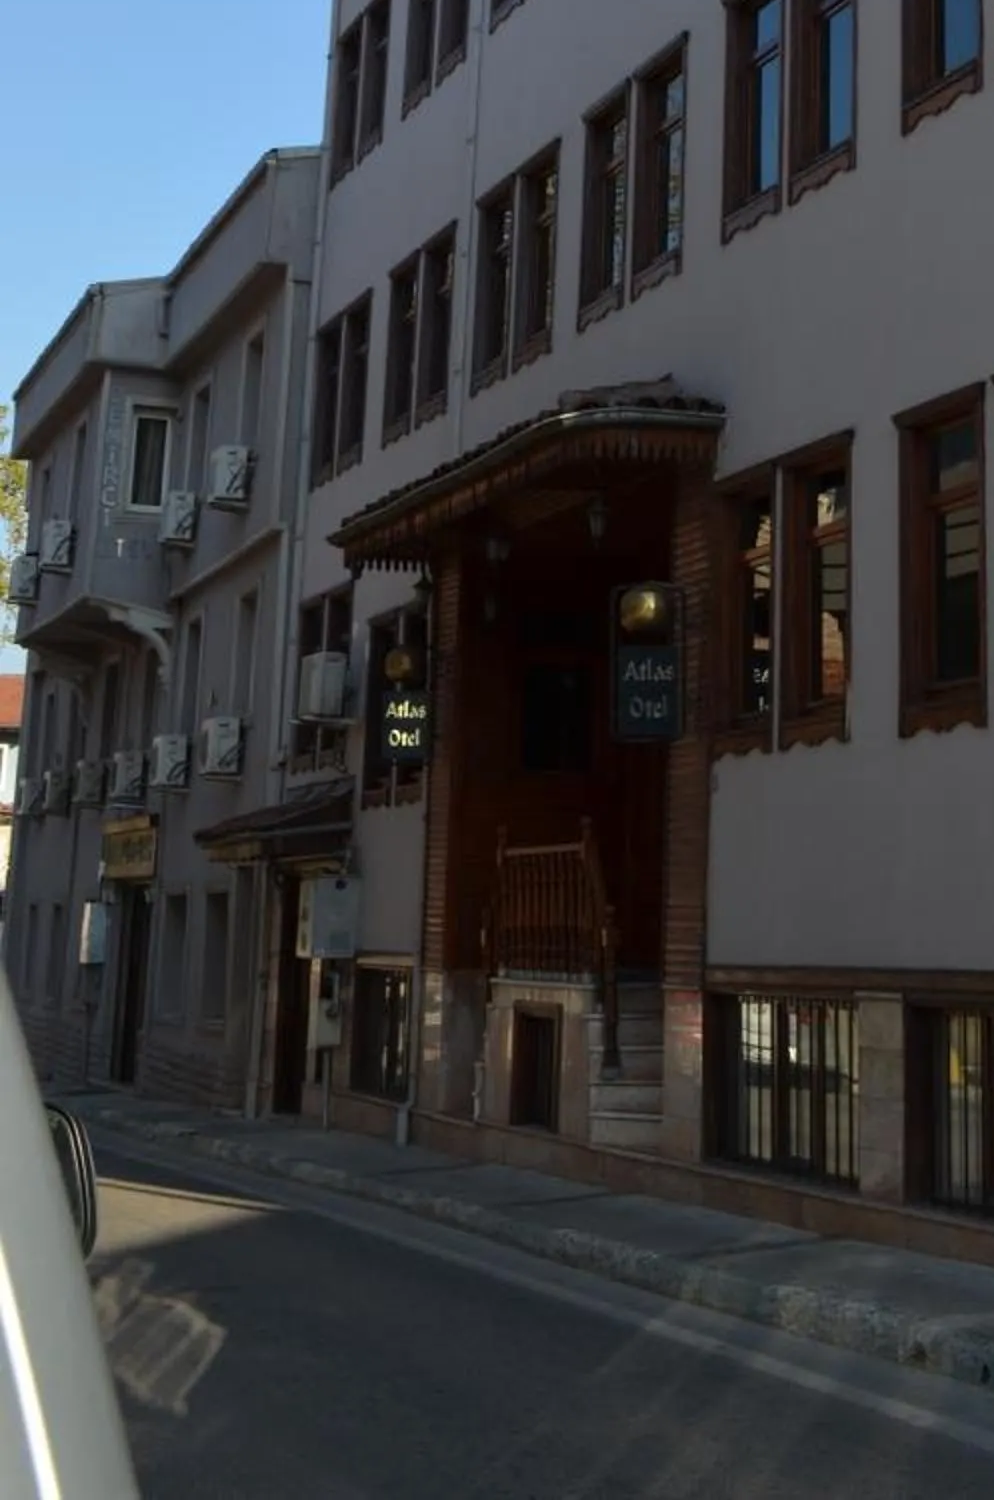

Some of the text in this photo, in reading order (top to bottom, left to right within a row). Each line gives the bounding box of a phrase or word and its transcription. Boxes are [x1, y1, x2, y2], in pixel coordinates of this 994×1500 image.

[622, 658, 674, 681] Atlas
[386, 700, 426, 719] Atlas
[629, 696, 667, 720] Otel
[388, 727, 420, 747] Otel
